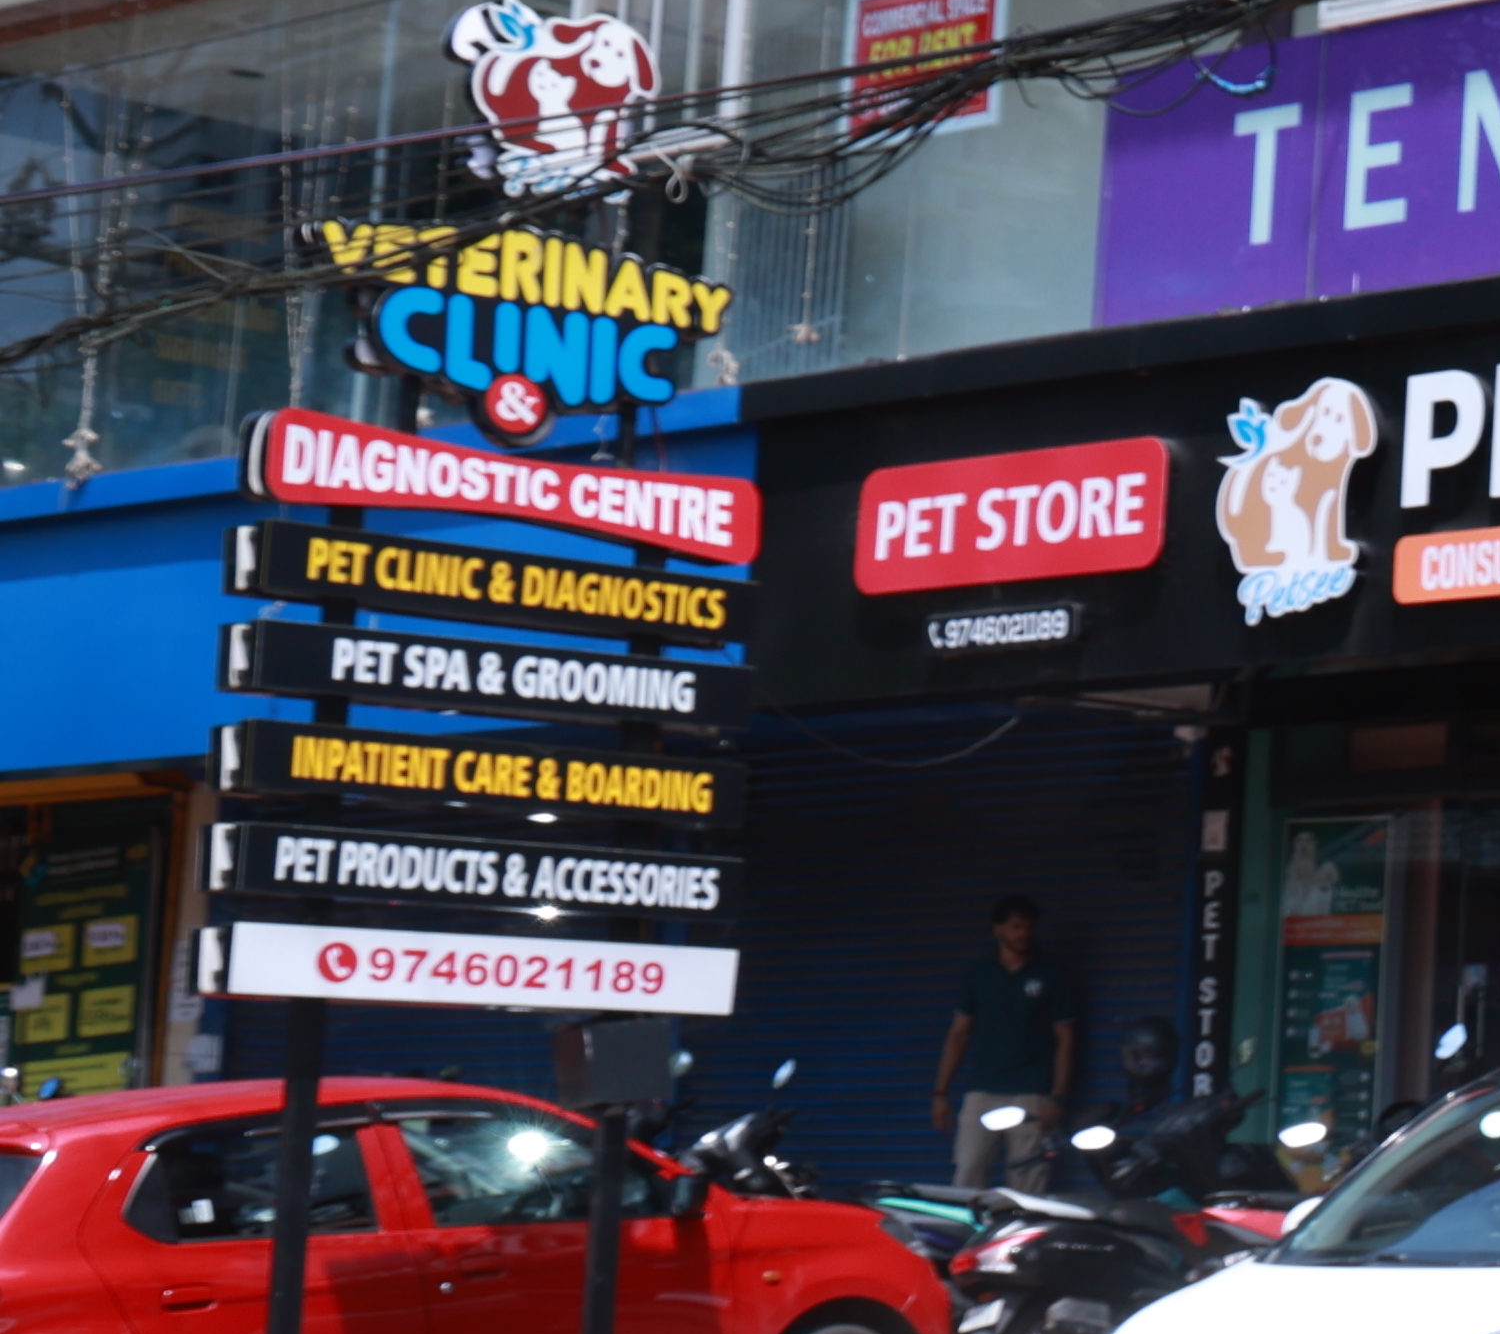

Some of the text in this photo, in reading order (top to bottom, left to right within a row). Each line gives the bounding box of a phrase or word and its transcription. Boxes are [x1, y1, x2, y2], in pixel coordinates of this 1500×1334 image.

[322, 218, 732, 336] VETERINARY
[379, 287, 678, 405] CLINIC
[495, 380, 537, 424] &
[282, 423, 734, 547] DIAGNOSTIC CENTRE
[873, 471, 1147, 561] PET STORE
[307, 537, 727, 630] PET CLINIC & DIAGNOSTICS
[1240, 567, 1354, 623] Petsee
[332, 637, 696, 713] PET SPA & GROOMING
[291, 735, 713, 815] INPATIENT CARE BOARDING
[274, 835, 720, 910] PET PRODUCTS ACCESSORIES
[368, 947, 665, 995] 9746021189
